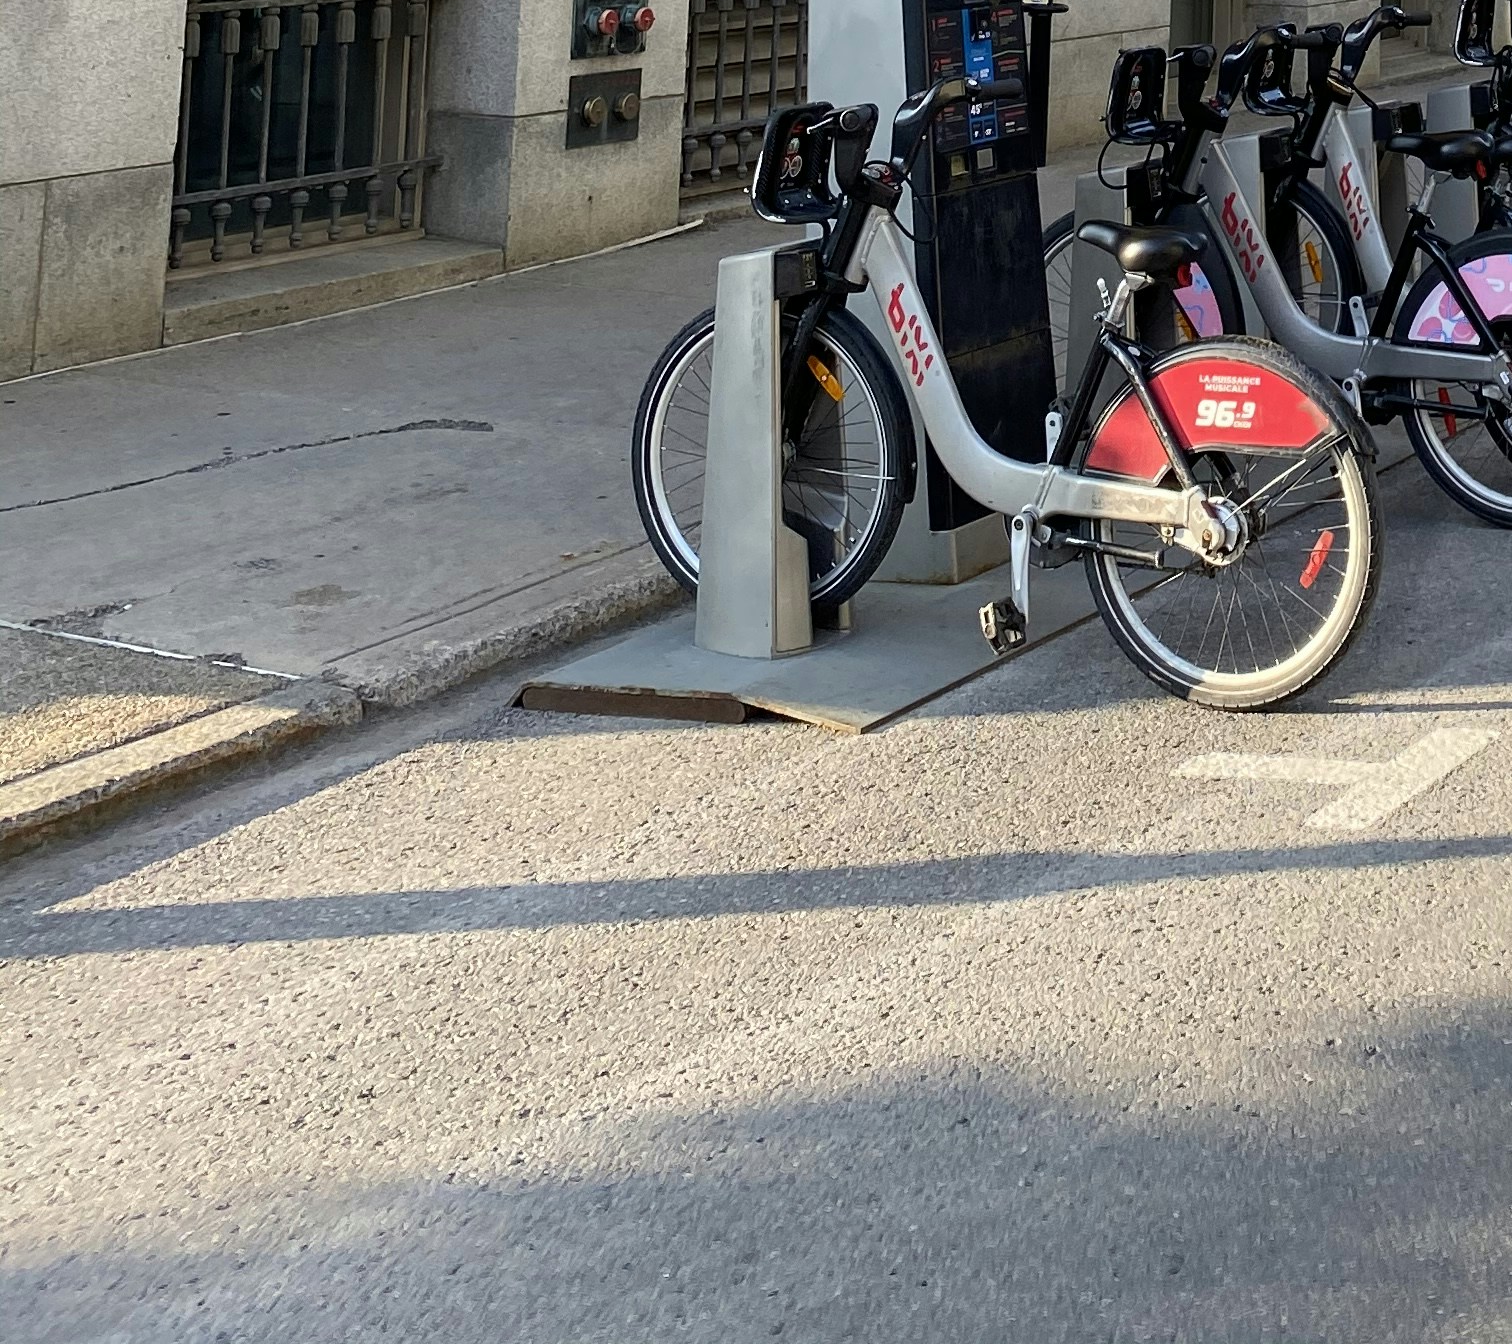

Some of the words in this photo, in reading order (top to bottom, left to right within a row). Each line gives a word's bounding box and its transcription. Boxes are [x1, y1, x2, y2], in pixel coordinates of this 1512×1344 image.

[1198, 374, 1211, 384] LA
[1211, 375, 1261, 386] PUISSANCE
[1204, 383, 1249, 393] MUSICALE
[1194, 399, 1256, 427] 96.9
